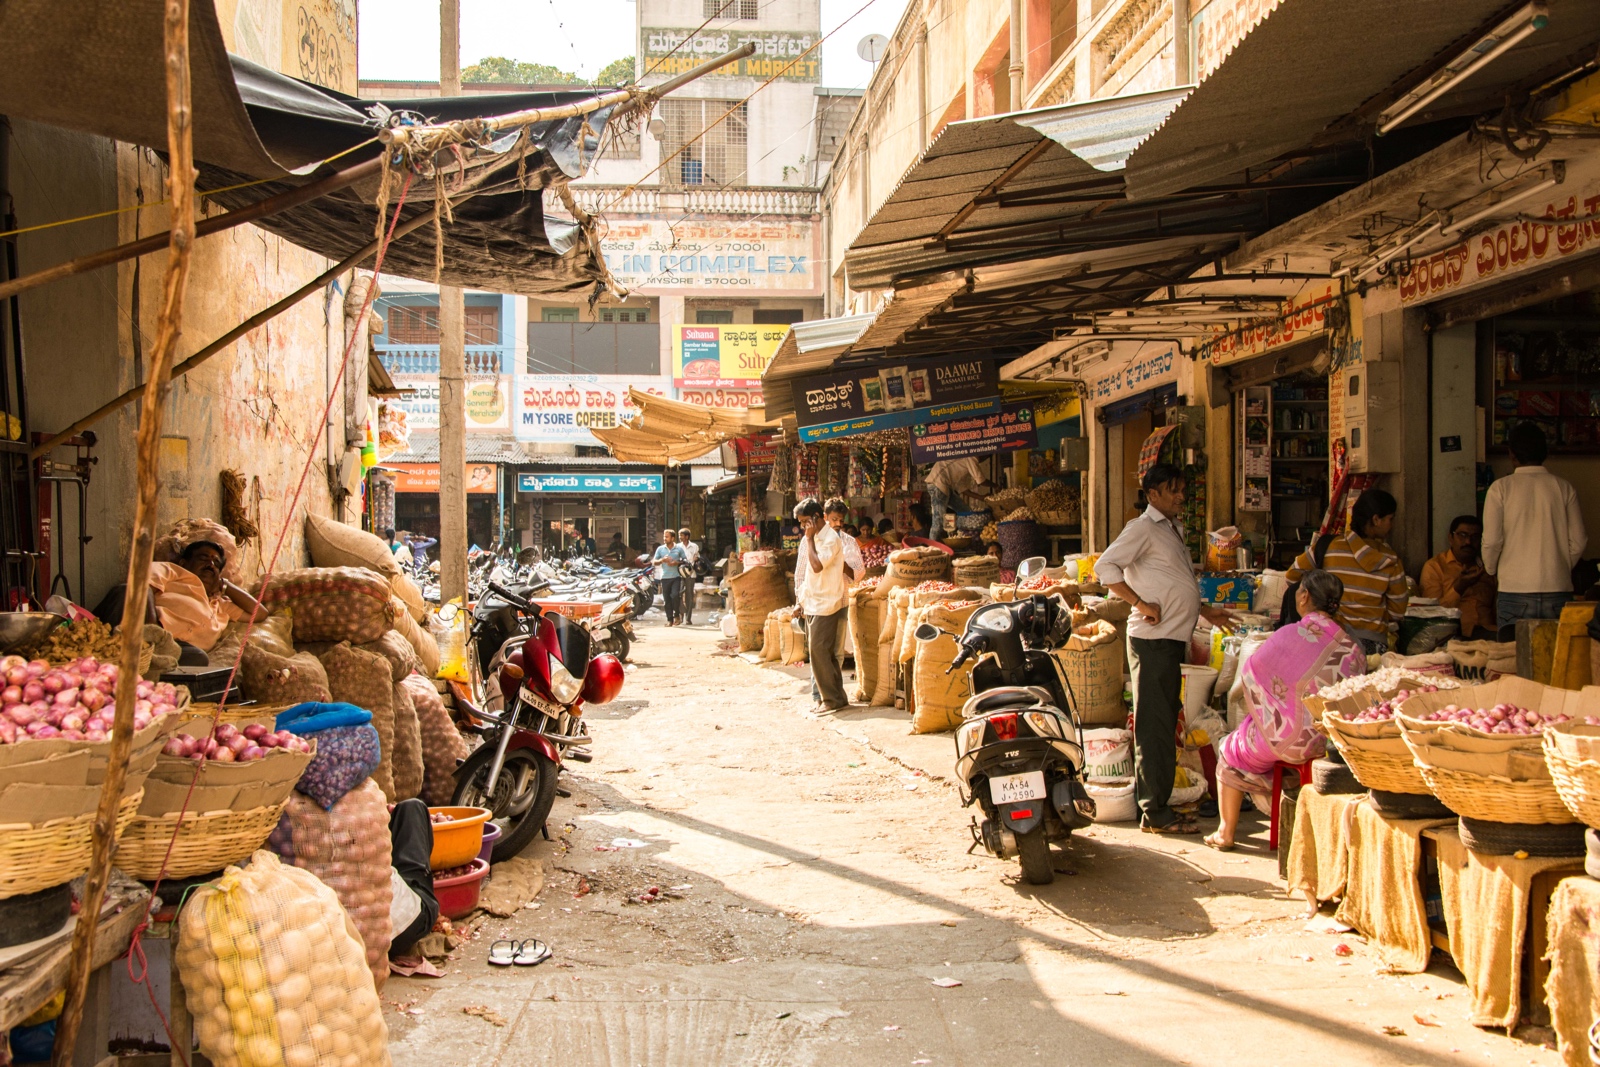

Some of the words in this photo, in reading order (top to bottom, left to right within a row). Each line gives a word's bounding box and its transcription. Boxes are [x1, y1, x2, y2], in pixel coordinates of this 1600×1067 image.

[746, 59, 817, 76] MARKET
[659, 255, 807, 274] COMPLEX
[646, 277, 694, 285] MYSORE
[686, 329, 714, 339] Suhana
[763, 331, 785, 340] ಅಡು
[935, 361, 983, 381] DAAWAT
[941, 376, 969, 386] BASMATI
[523, 387, 580, 410] ಮೈಸೂರು
[586, 390, 616, 408] ಕಾಫಿ
[806, 380, 854, 405] ದಾವತ್
[930, 406, 960, 416] Sapthagiri
[960, 403, 974, 411] Food
[974, 401, 993, 409] Bazaar
[523, 412, 573, 424] MYSORE
[576, 411, 616, 427] COFFEE
[916, 434, 947, 446] GANESH
[983, 427, 1004, 437] DRUG
[1005, 422, 1031, 434] HOUSE
[936, 449, 968, 457] Medicines
[969, 445, 997, 453] available
[523, 476, 579, 491] ಮೈಸೂರು
[584, 478, 613, 488] ಕಾಫಿ
[533, 498, 542, 545] MYSORE
[1005, 750, 1019, 758] TVS
